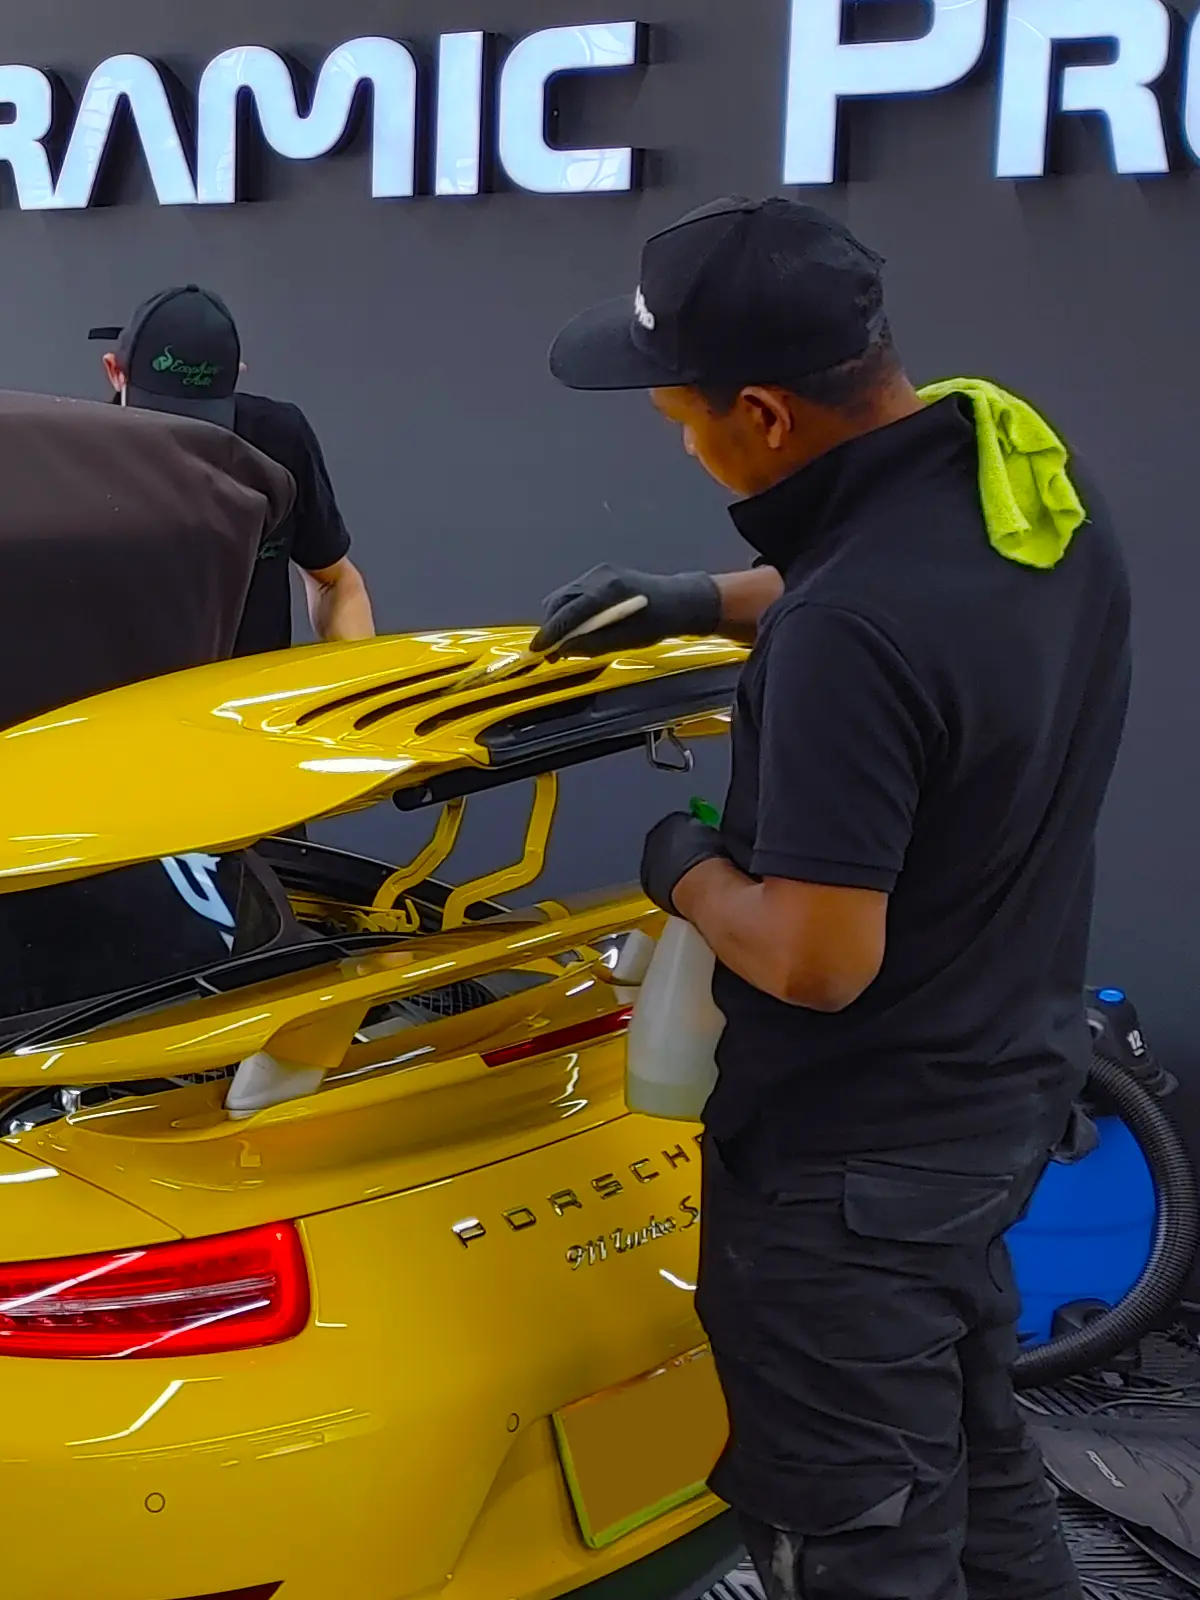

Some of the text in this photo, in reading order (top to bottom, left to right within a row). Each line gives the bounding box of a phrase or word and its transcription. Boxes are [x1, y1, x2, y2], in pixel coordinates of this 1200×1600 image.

[783, 0, 1200, 185] PR
[565, 1235, 607, 1271] 911
[678, 1194, 700, 1232] S
